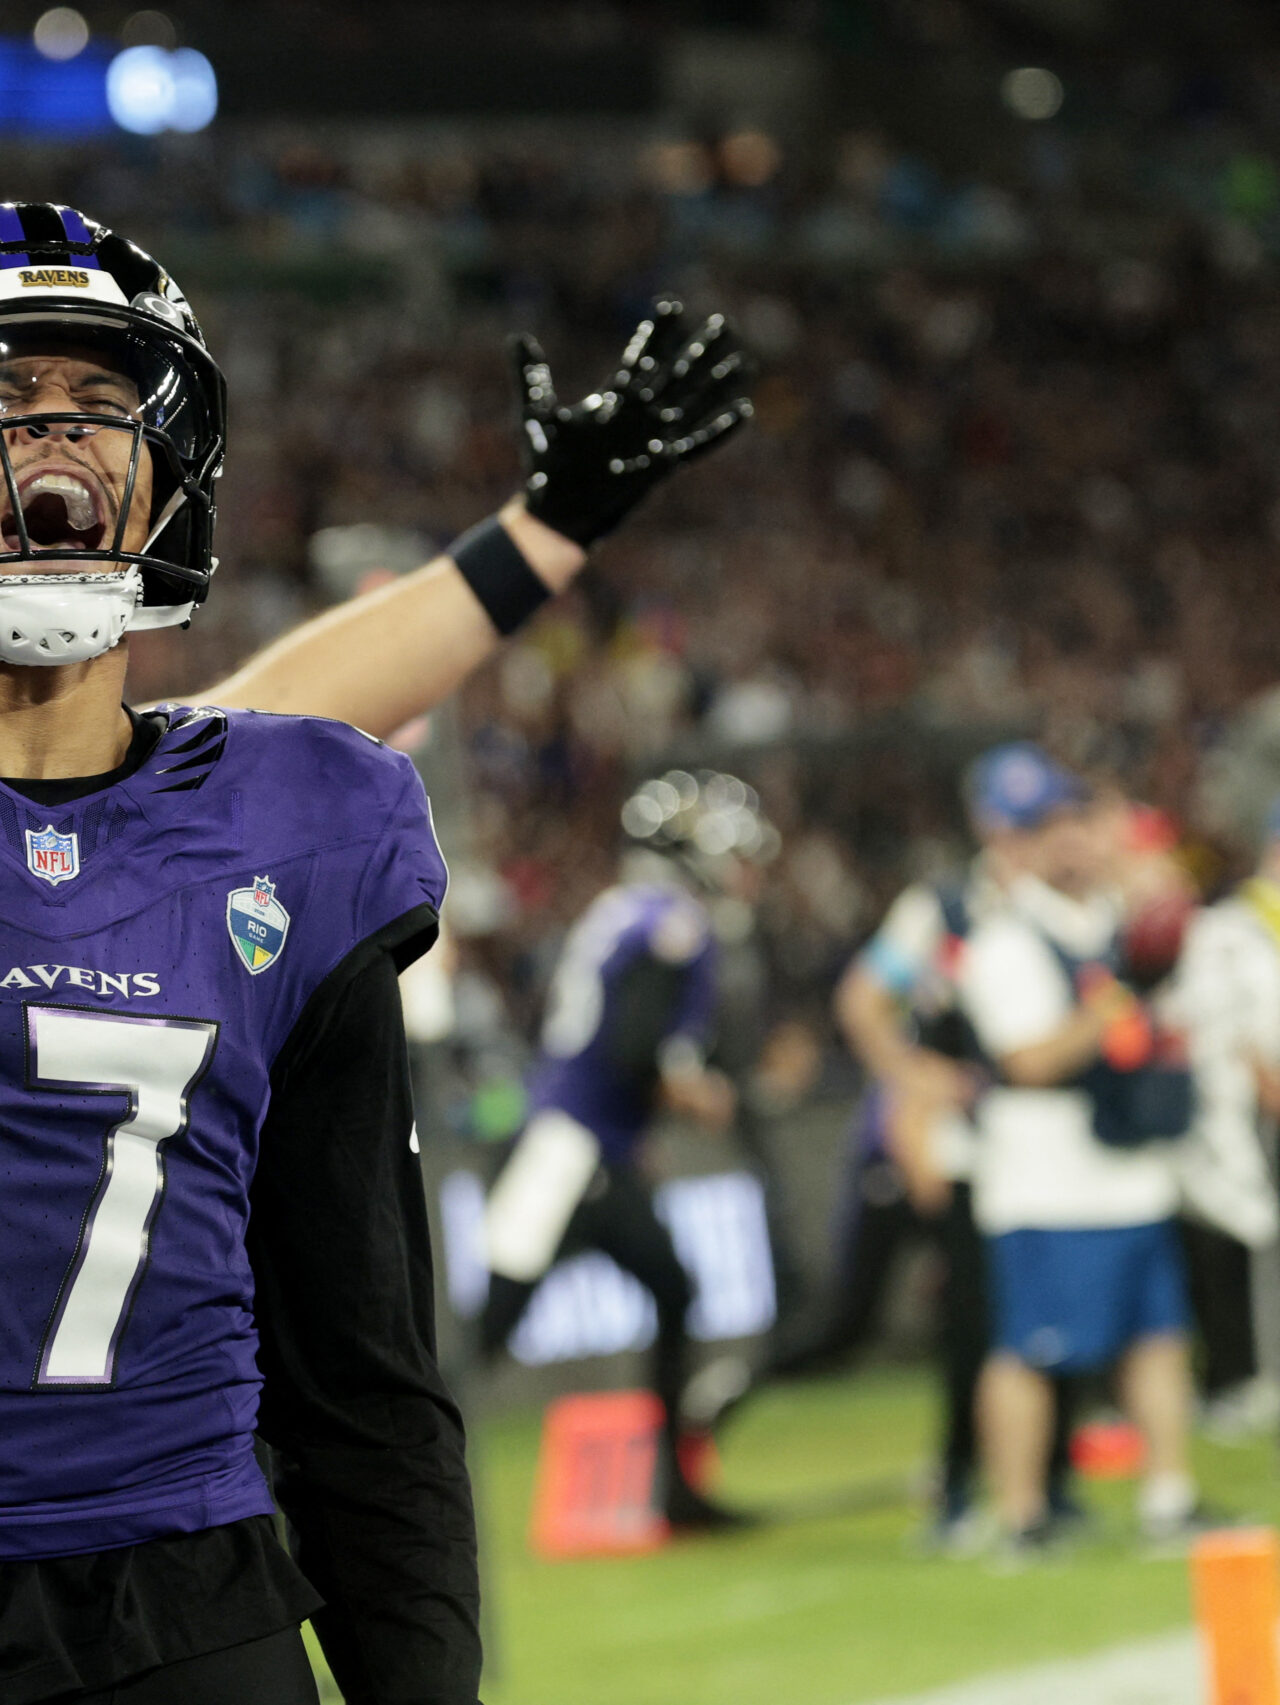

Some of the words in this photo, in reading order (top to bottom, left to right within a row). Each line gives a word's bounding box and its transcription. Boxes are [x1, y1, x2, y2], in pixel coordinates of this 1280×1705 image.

[19, 269, 89, 288] RAVENS
[35, 850, 71, 873] NFL
[255, 889, 269, 904] NFL
[248, 920, 267, 938] RIO
